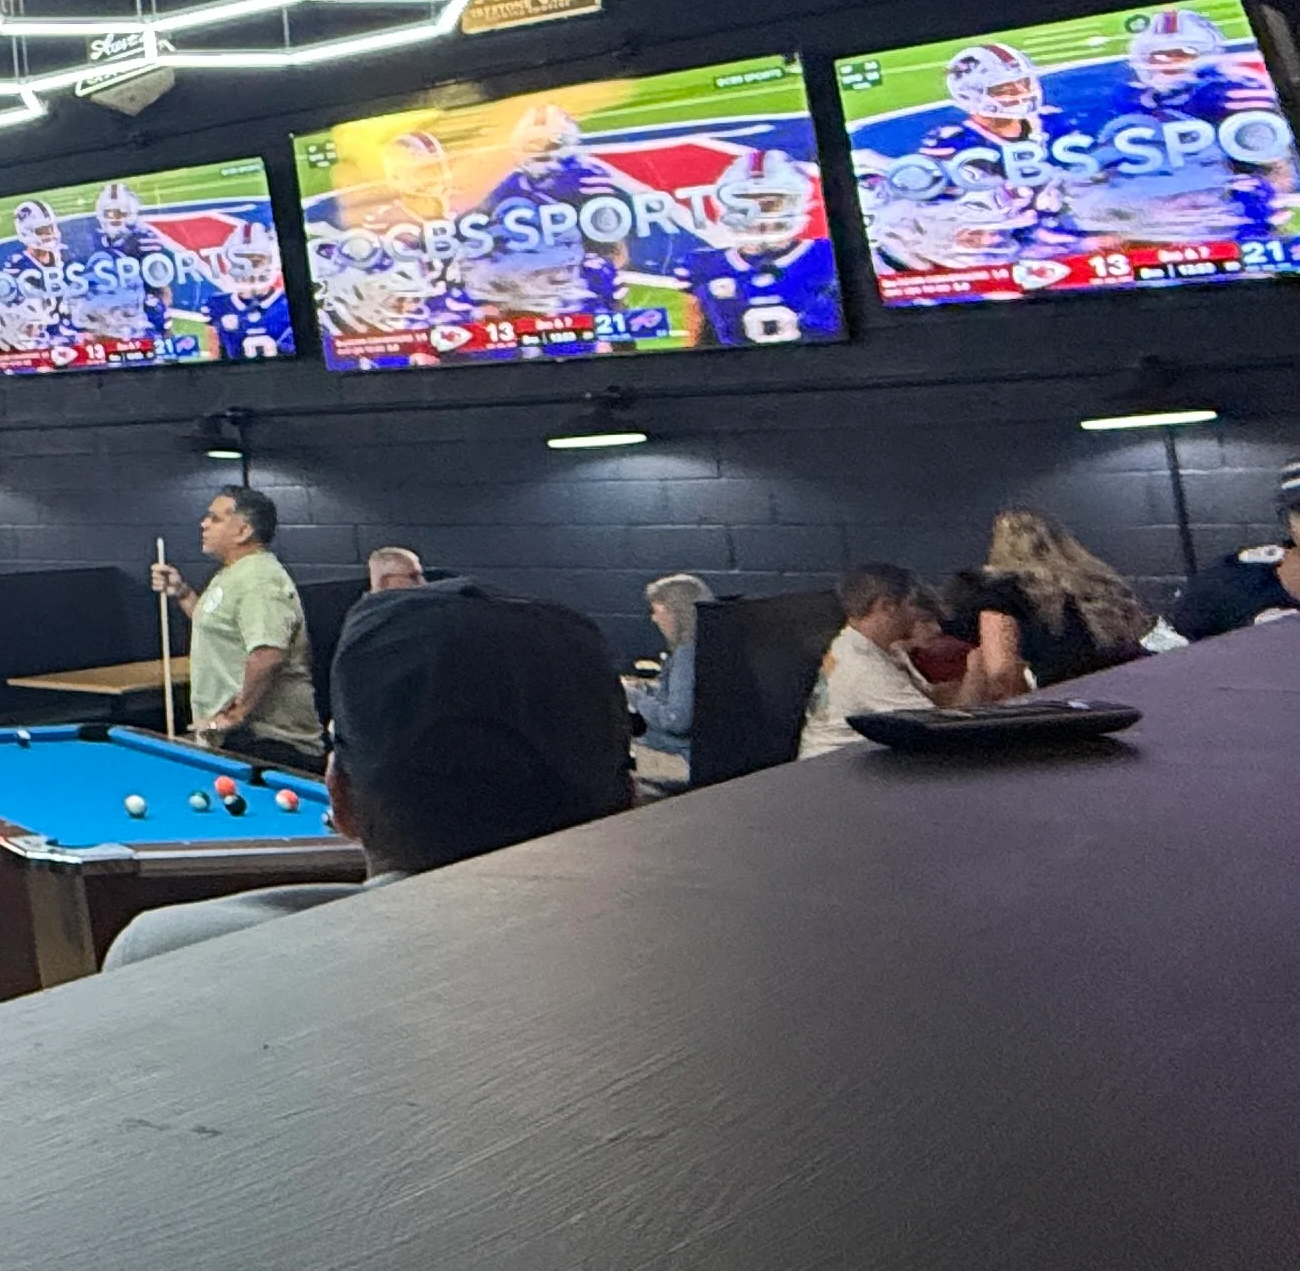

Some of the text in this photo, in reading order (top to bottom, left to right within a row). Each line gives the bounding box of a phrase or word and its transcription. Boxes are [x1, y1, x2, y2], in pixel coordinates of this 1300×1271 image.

[948, 132, 1100, 191] CBS
[382, 183, 762, 262] CBS SPORTS
[1242, 240, 1285, 263] 21
[17, 247, 255, 300] CBS SPORTS
[1088, 253, 1130, 277] 13
[485, 322, 515, 342] 13
[595, 313, 626, 333] 21
[87, 344, 104, 360] 13
[155, 338, 174, 355] 21
